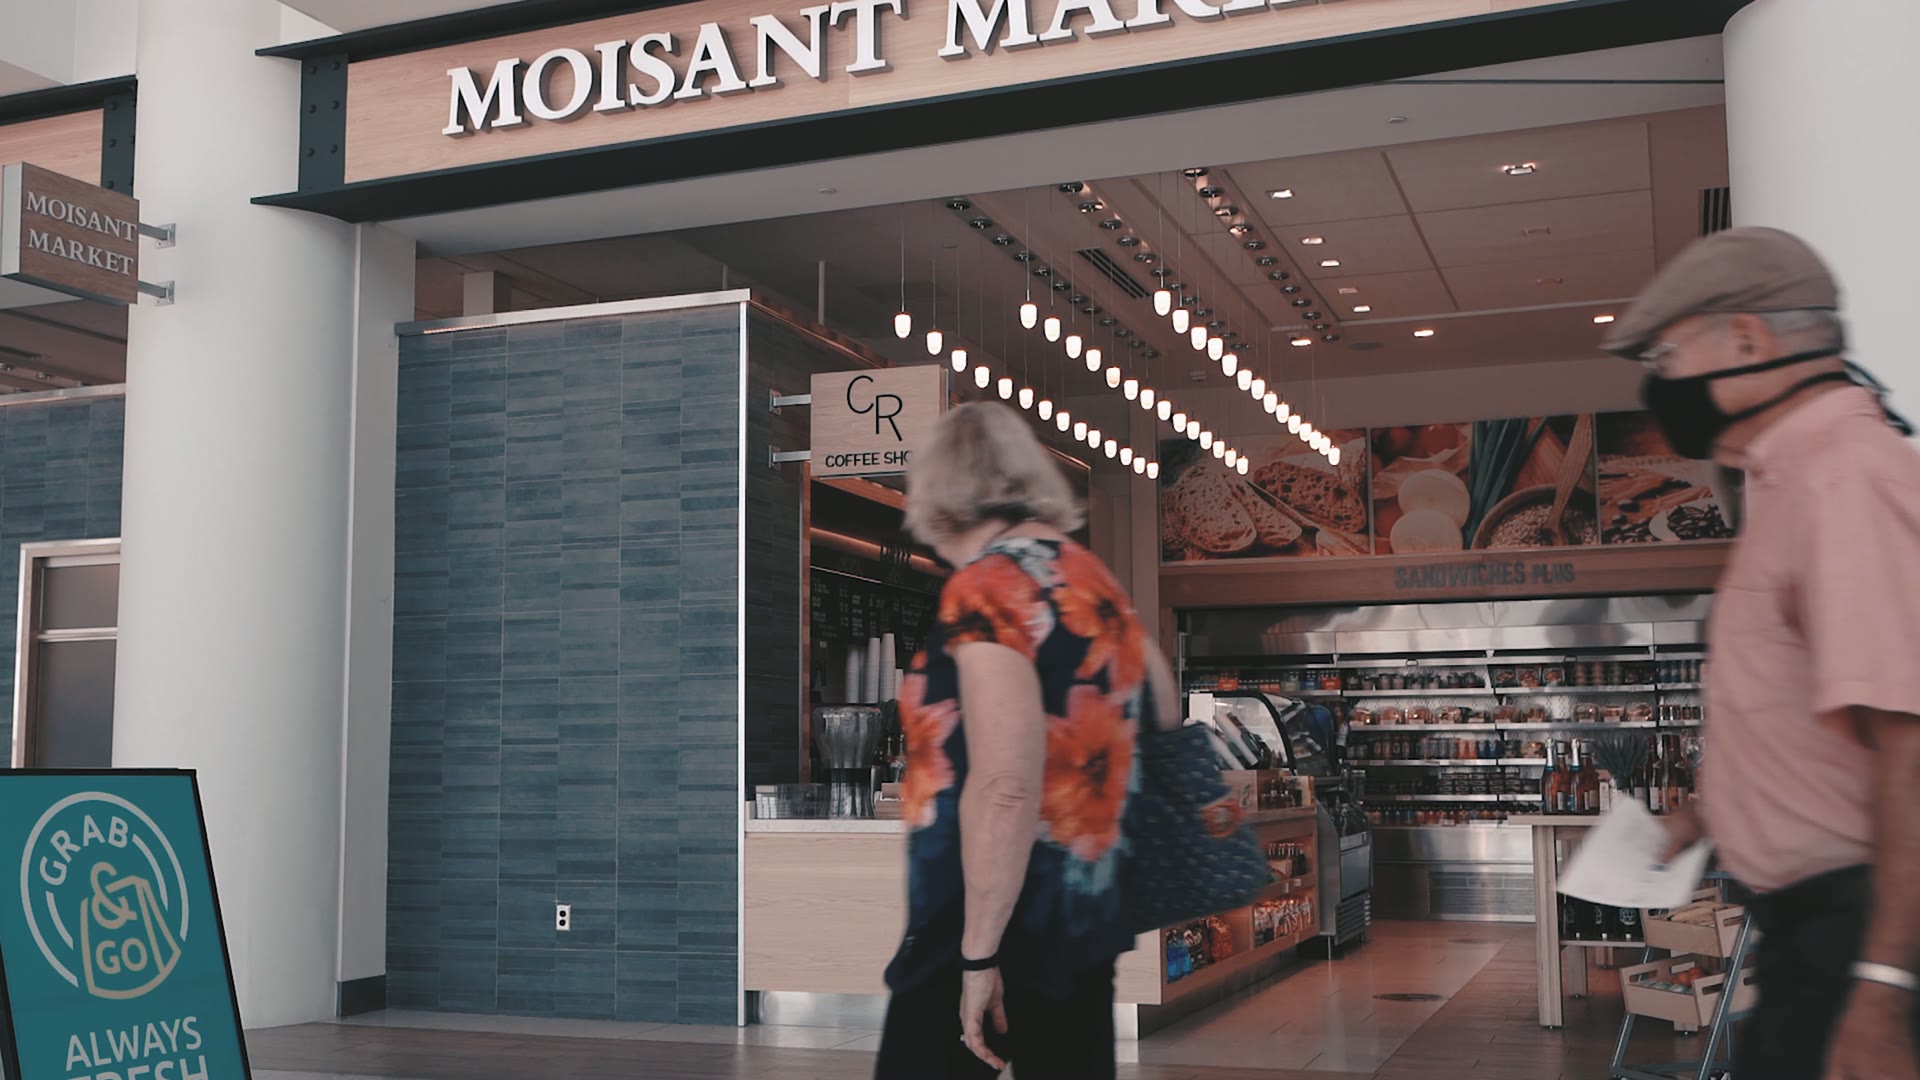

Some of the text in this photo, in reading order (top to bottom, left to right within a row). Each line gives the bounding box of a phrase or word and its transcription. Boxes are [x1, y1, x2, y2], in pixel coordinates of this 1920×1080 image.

[441, 0, 903, 135] MOISANT
[26, 191, 137, 243] MOISANT
[28, 228, 134, 275] MARKET
[825, 451, 913, 467] COFFEE SHO
[1395, 561, 1576, 589] SANDWICHES PLUS
[39, 814, 129, 886] GRAB
[96, 937, 148, 975] GO
[65, 1015, 202, 1072] ALWAYS
